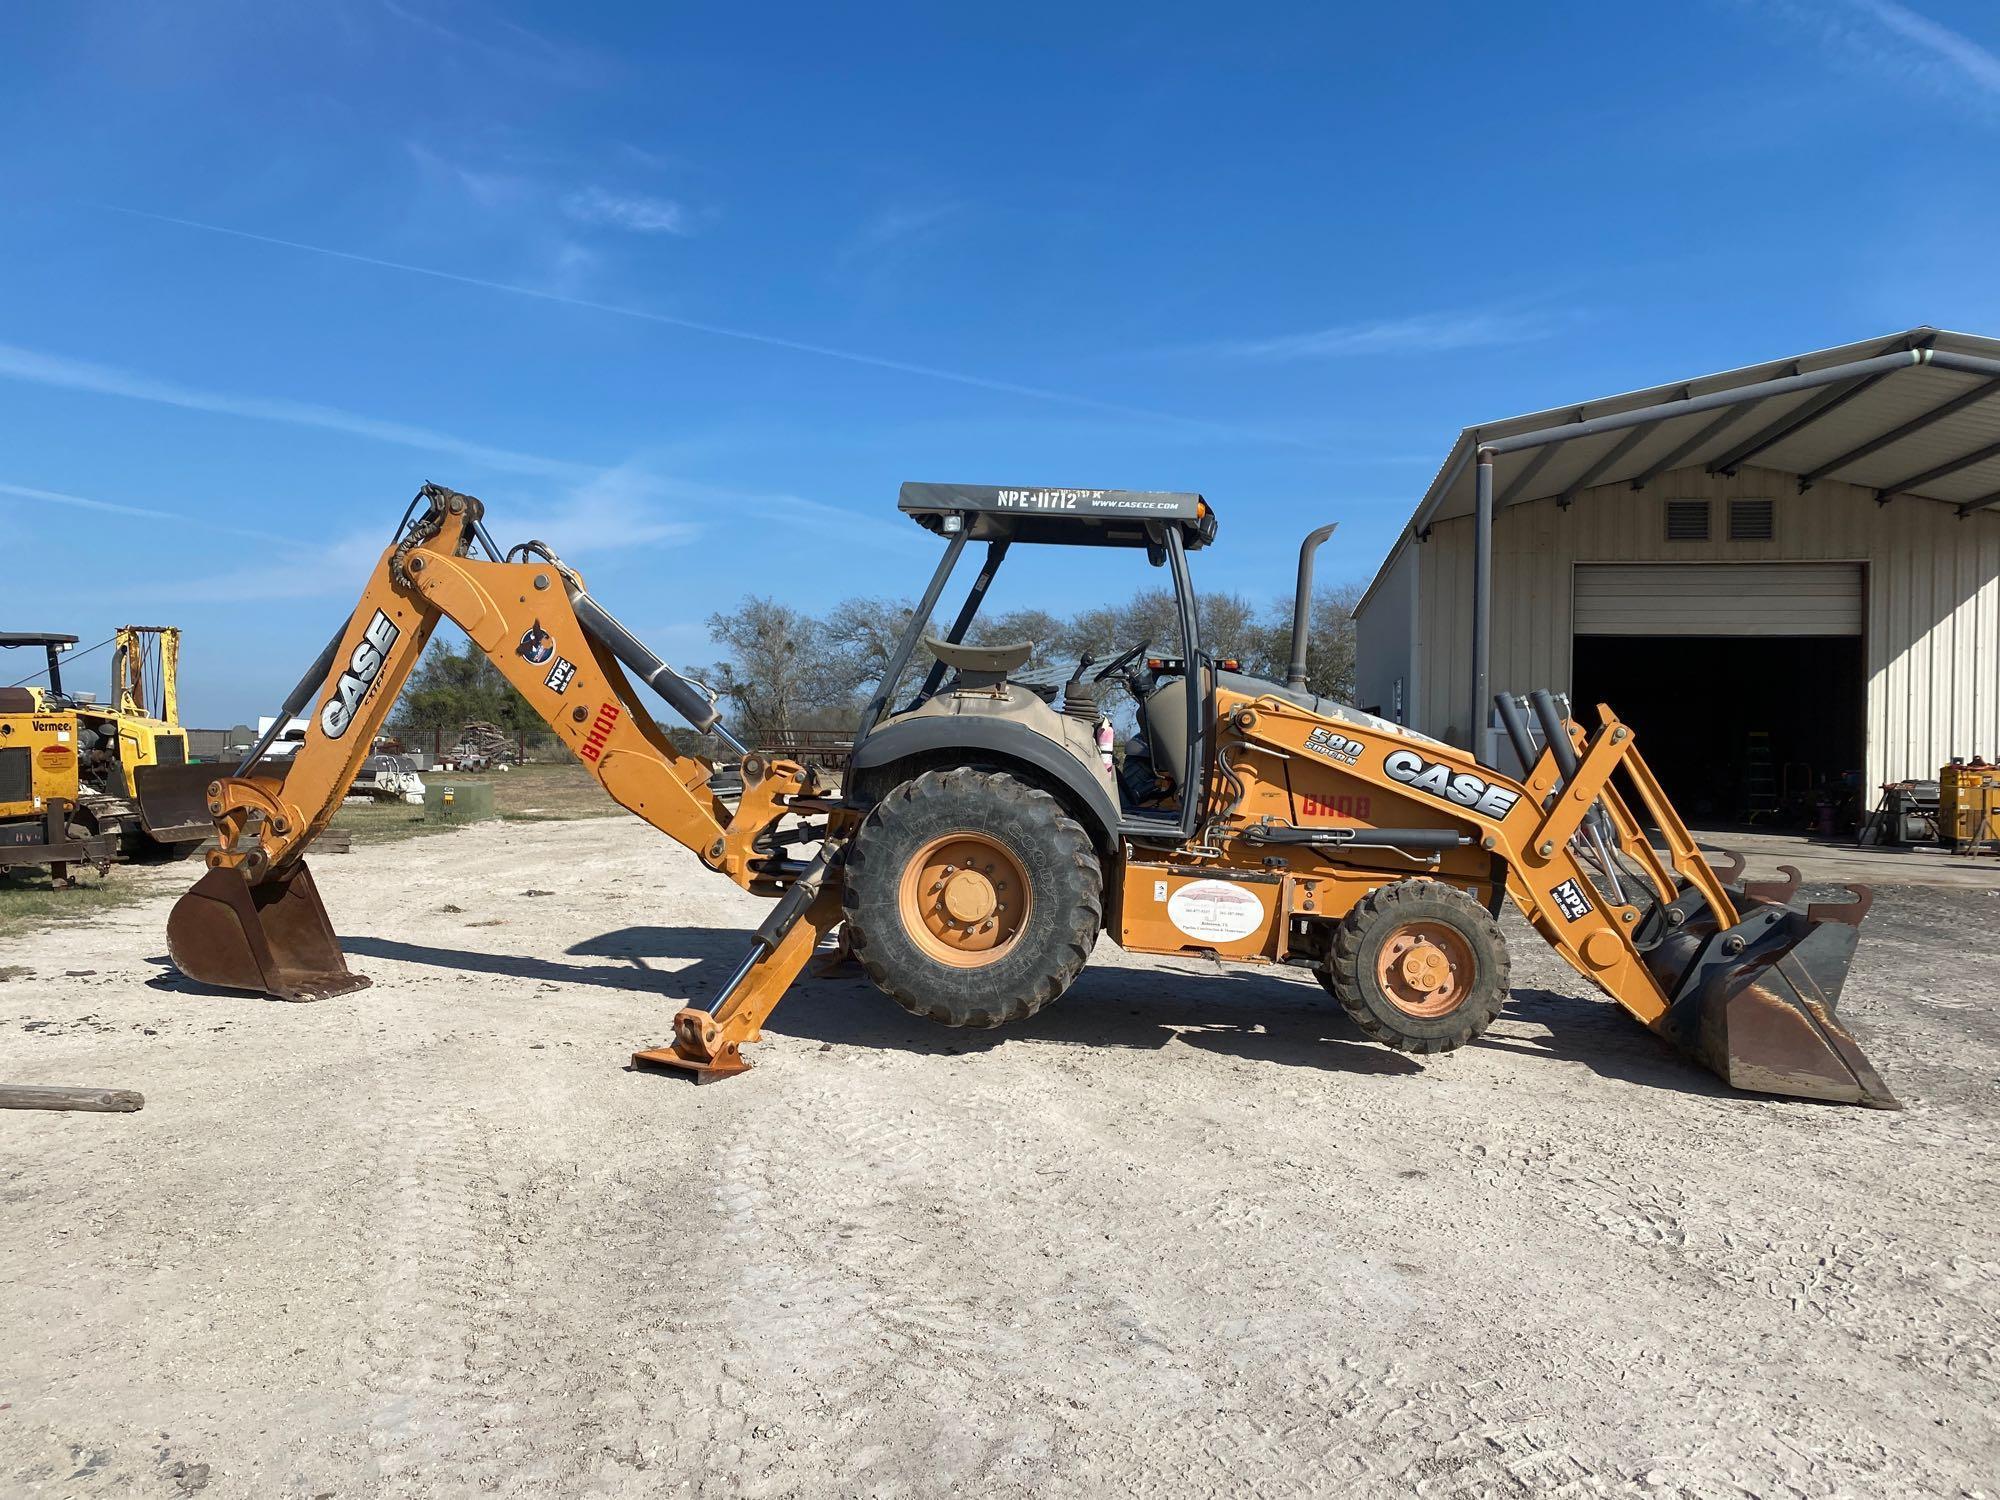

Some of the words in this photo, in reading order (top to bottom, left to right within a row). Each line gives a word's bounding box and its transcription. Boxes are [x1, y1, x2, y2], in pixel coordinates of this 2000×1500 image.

[997, 490, 1077, 509] NPE-11712
[320, 607, 401, 740] CASE
[548, 659, 571, 691] NPE
[1304, 740, 1344, 762] SUPER
[1308, 726, 1365, 757] 580
[1383, 749, 1523, 822] CASE
[1557, 881, 1588, 918] NPE
